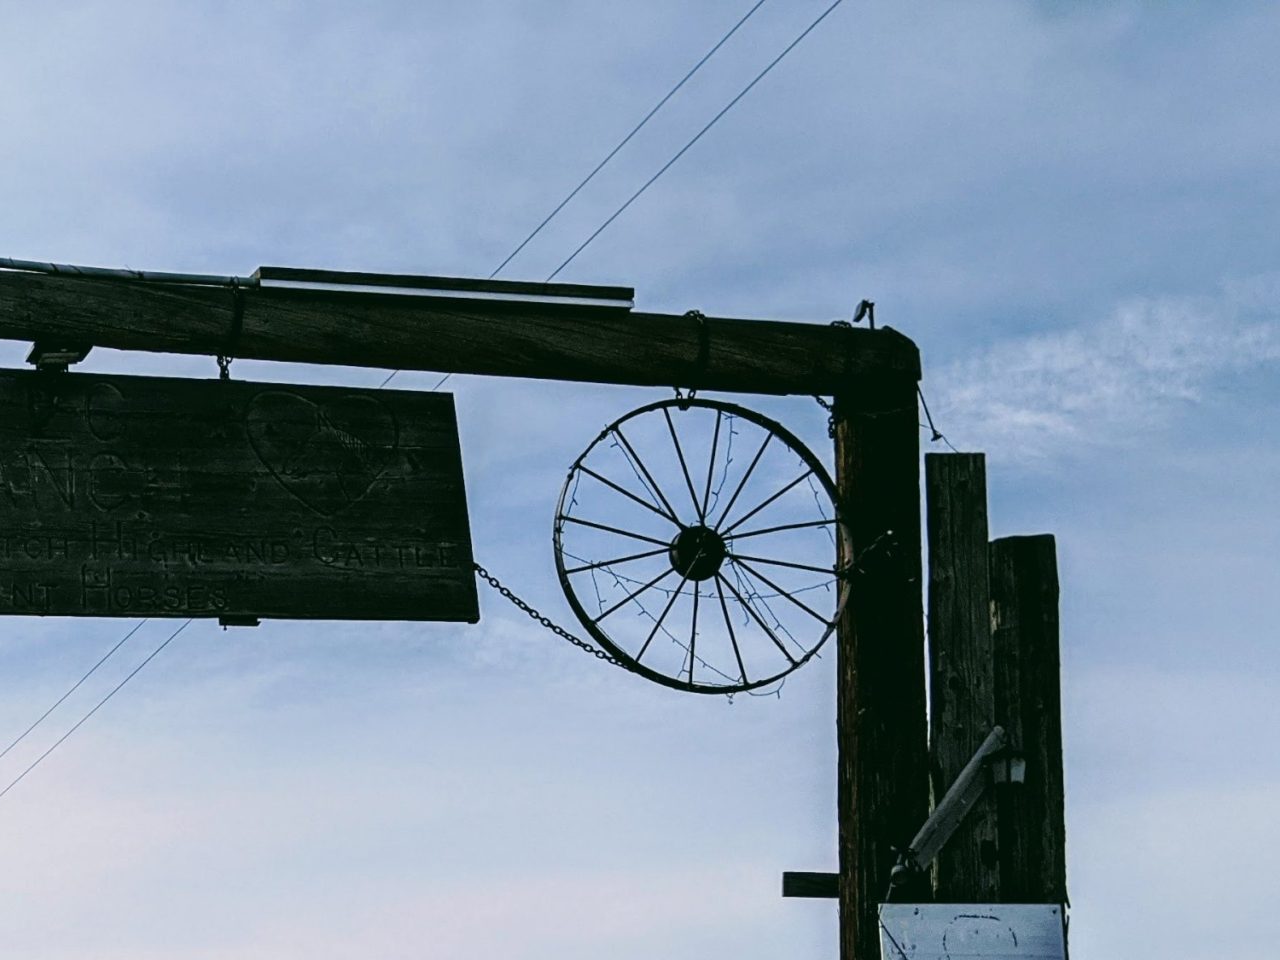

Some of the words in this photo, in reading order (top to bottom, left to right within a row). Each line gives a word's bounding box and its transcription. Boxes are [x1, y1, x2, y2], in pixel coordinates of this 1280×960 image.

[91, 519, 291, 567] HIGHLAND
[312, 525, 460, 571] CATTLE
[82, 564, 229, 611] HORSES
